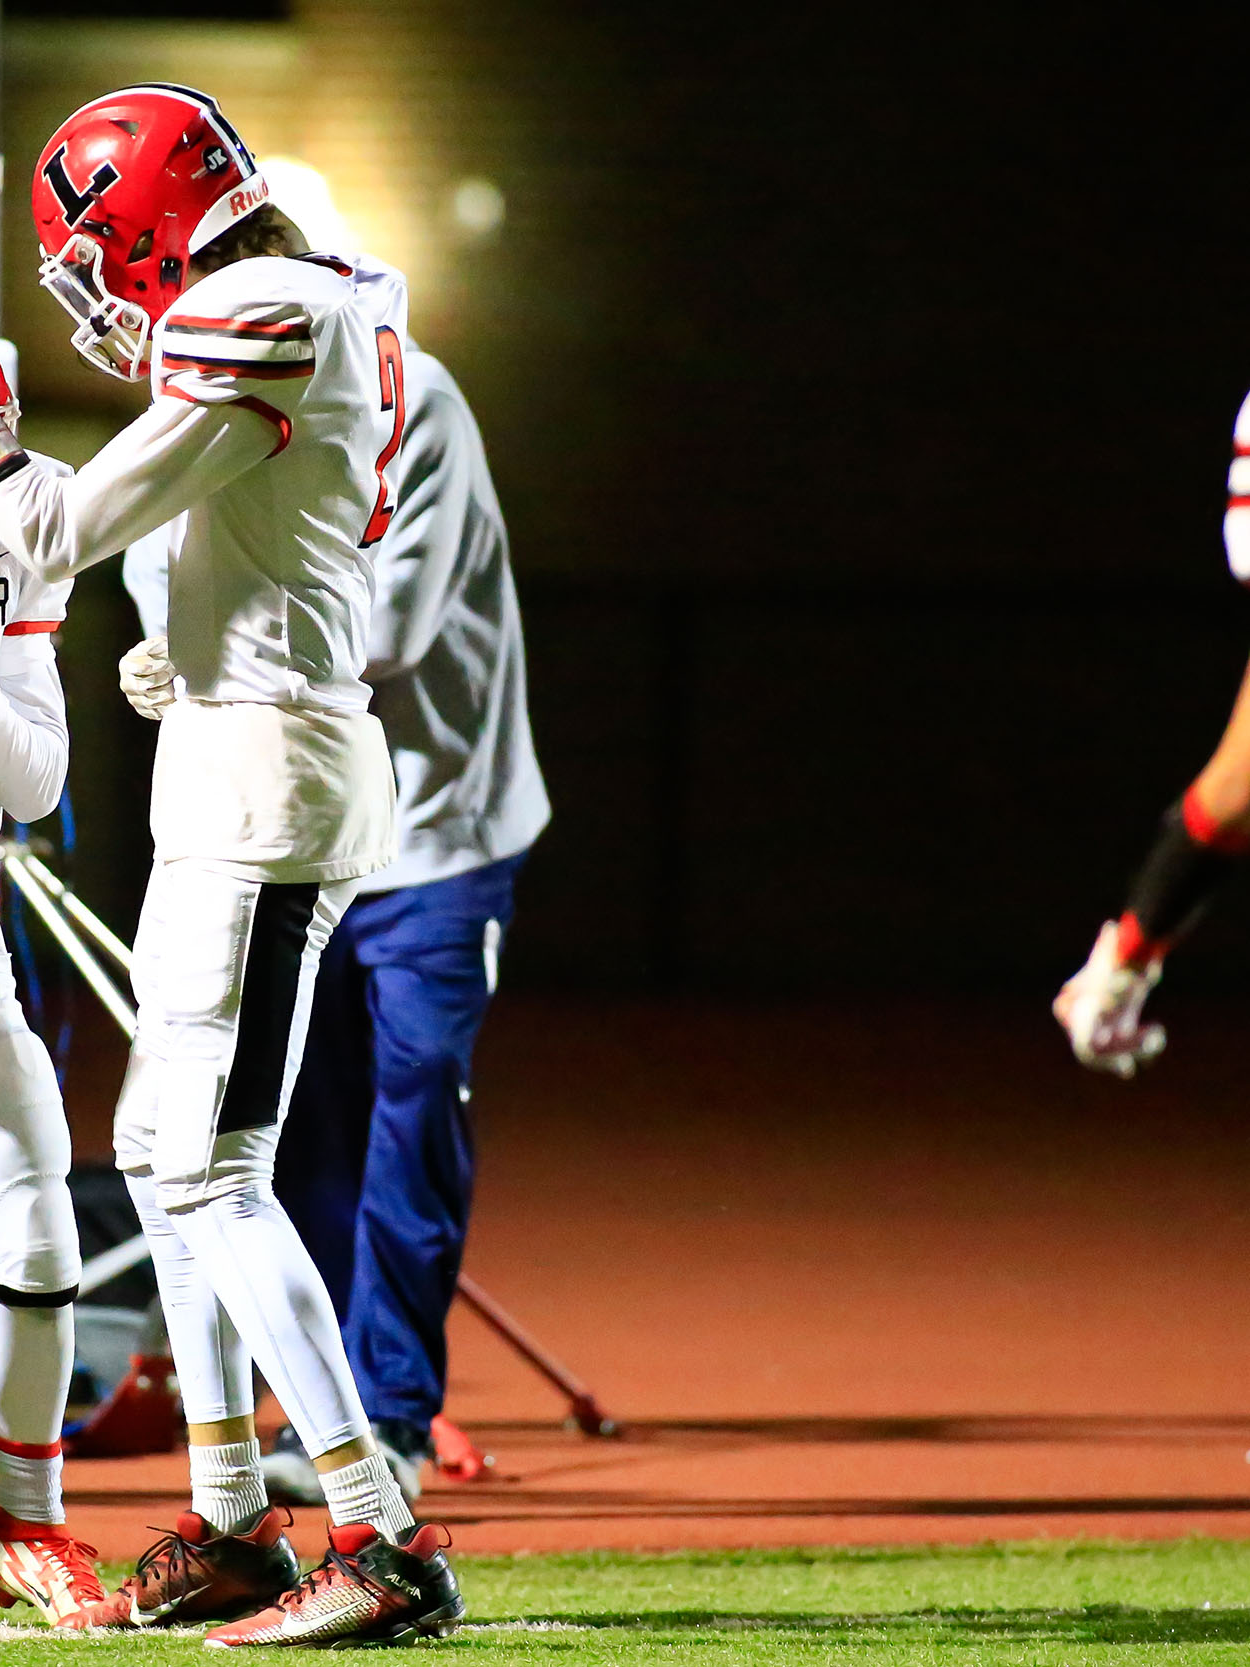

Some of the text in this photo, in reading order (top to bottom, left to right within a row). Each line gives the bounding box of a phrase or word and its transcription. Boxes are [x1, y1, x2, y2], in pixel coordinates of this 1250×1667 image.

[41, 140, 122, 230] L
[207, 148, 228, 171] JK
[357, 325, 406, 549] 2
